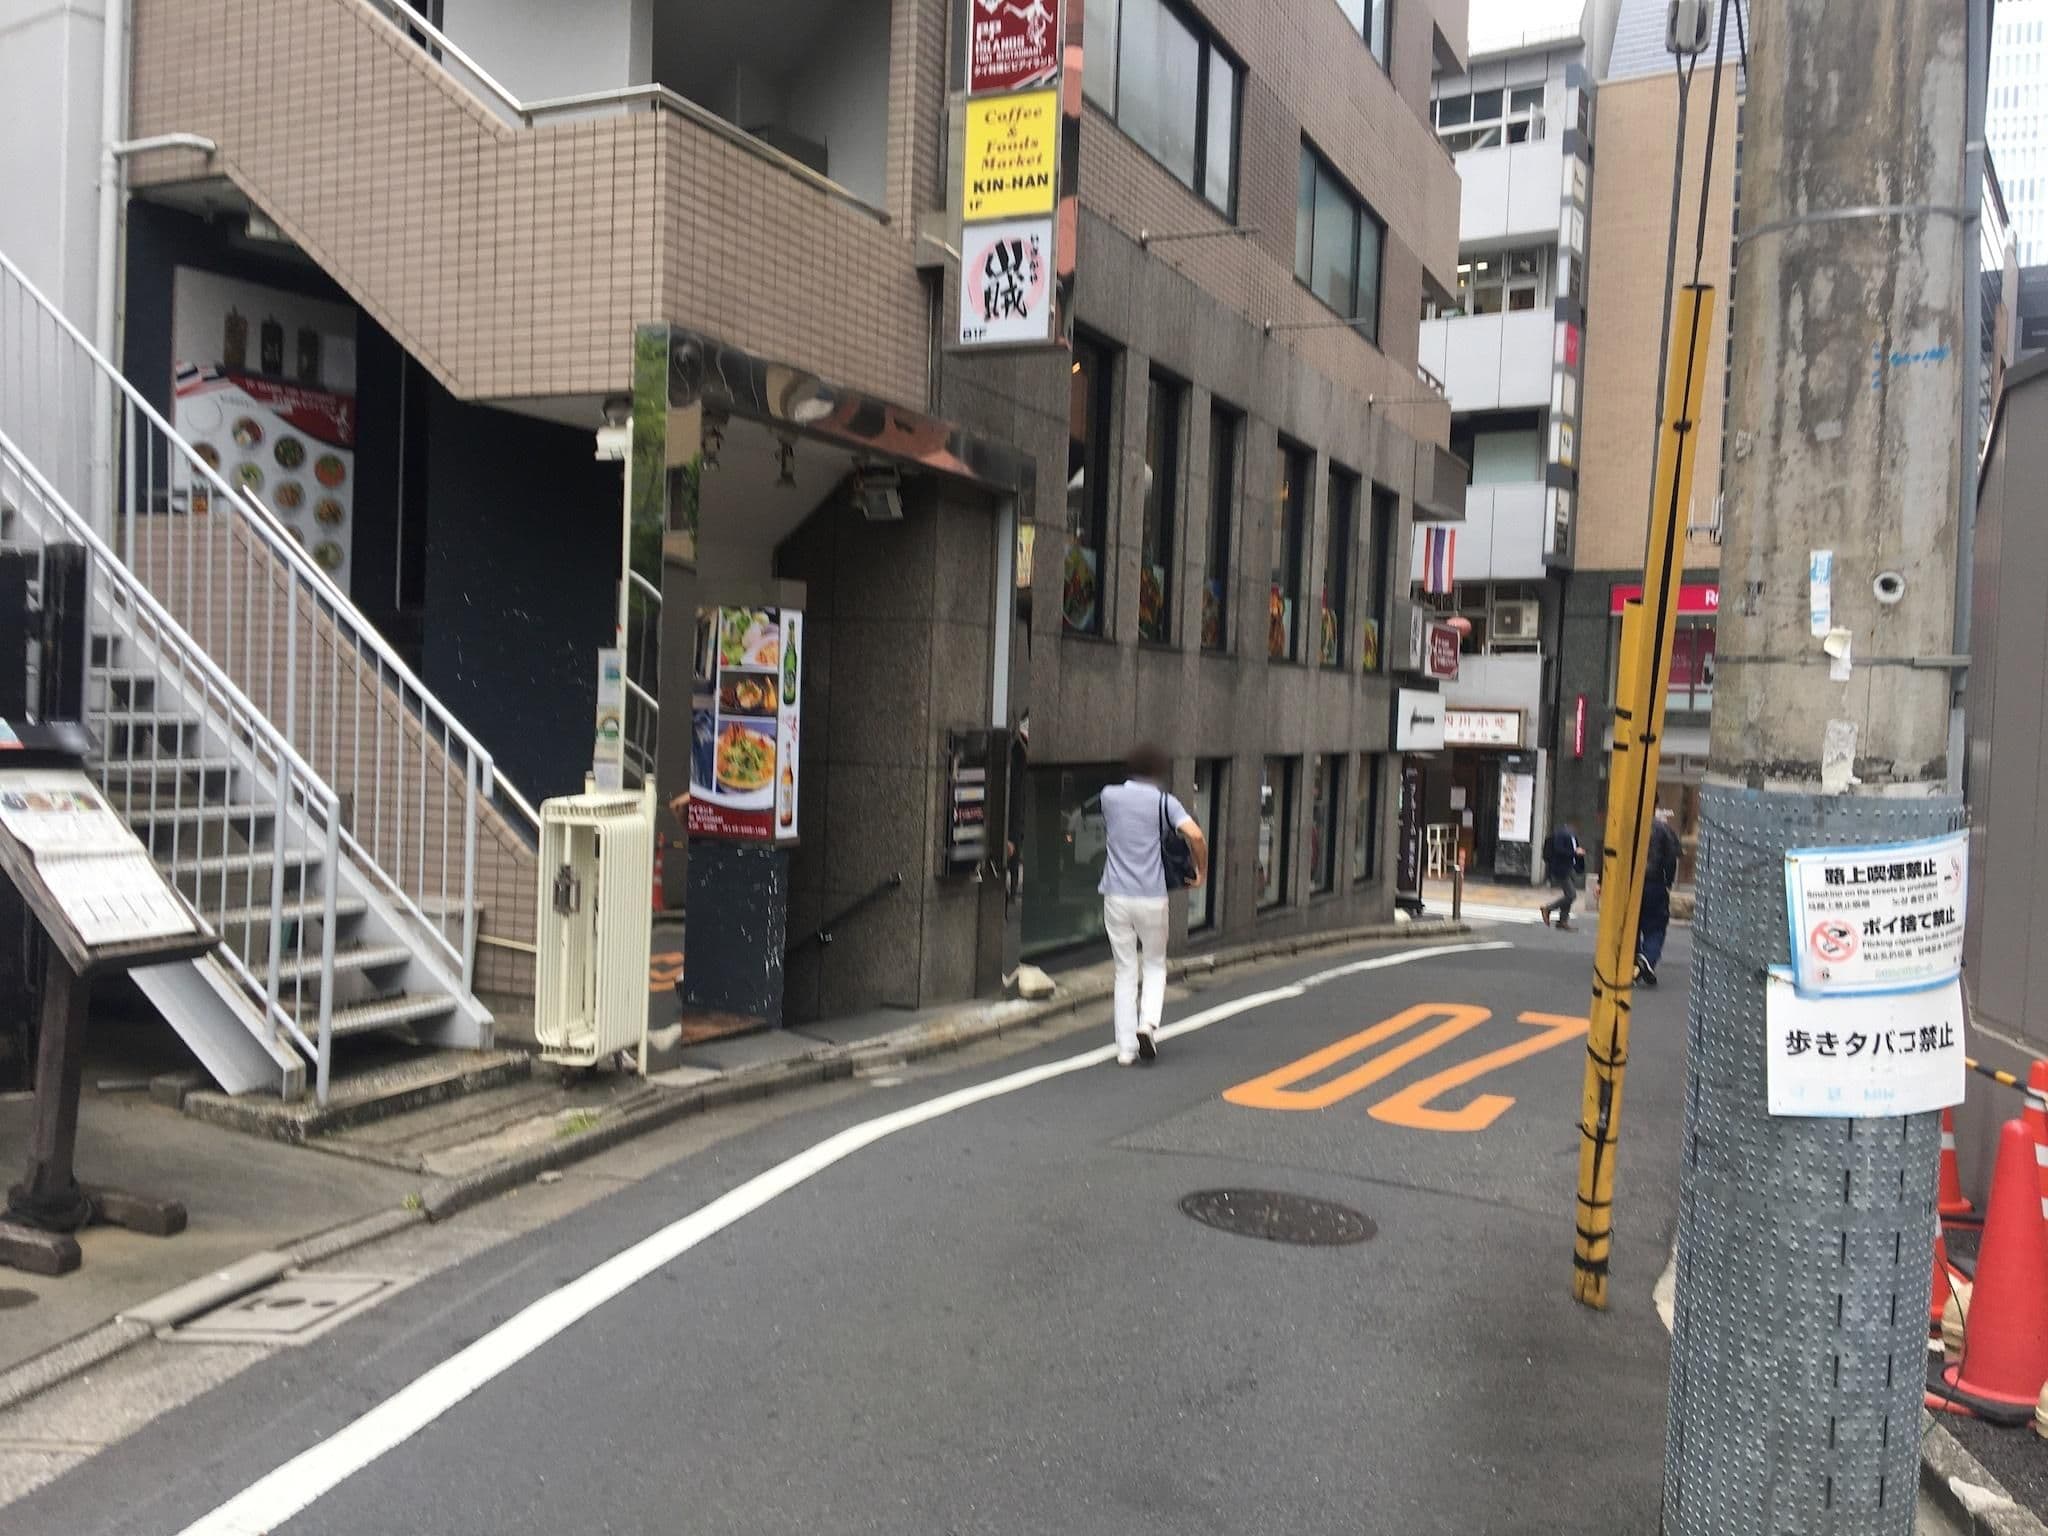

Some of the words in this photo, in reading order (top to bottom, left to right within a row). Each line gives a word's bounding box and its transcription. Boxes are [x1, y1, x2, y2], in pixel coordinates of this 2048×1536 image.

[985, 107, 1042, 124] Coffee
[986, 136, 1039, 154] Foods
[981, 154, 1042, 172] Market
[973, 172, 1049, 194] KIN-HAN
[1824, 858, 1938, 886] 路上喫煙禁止
[1845, 890, 1856, 898] on
[1857, 887, 1870, 897] the
[1871, 886, 1898, 896] streets
[1863, 906, 1955, 935] ポイ捨て禁止
[1785, 1021, 1955, 1057] 歩きタバコ禁止
